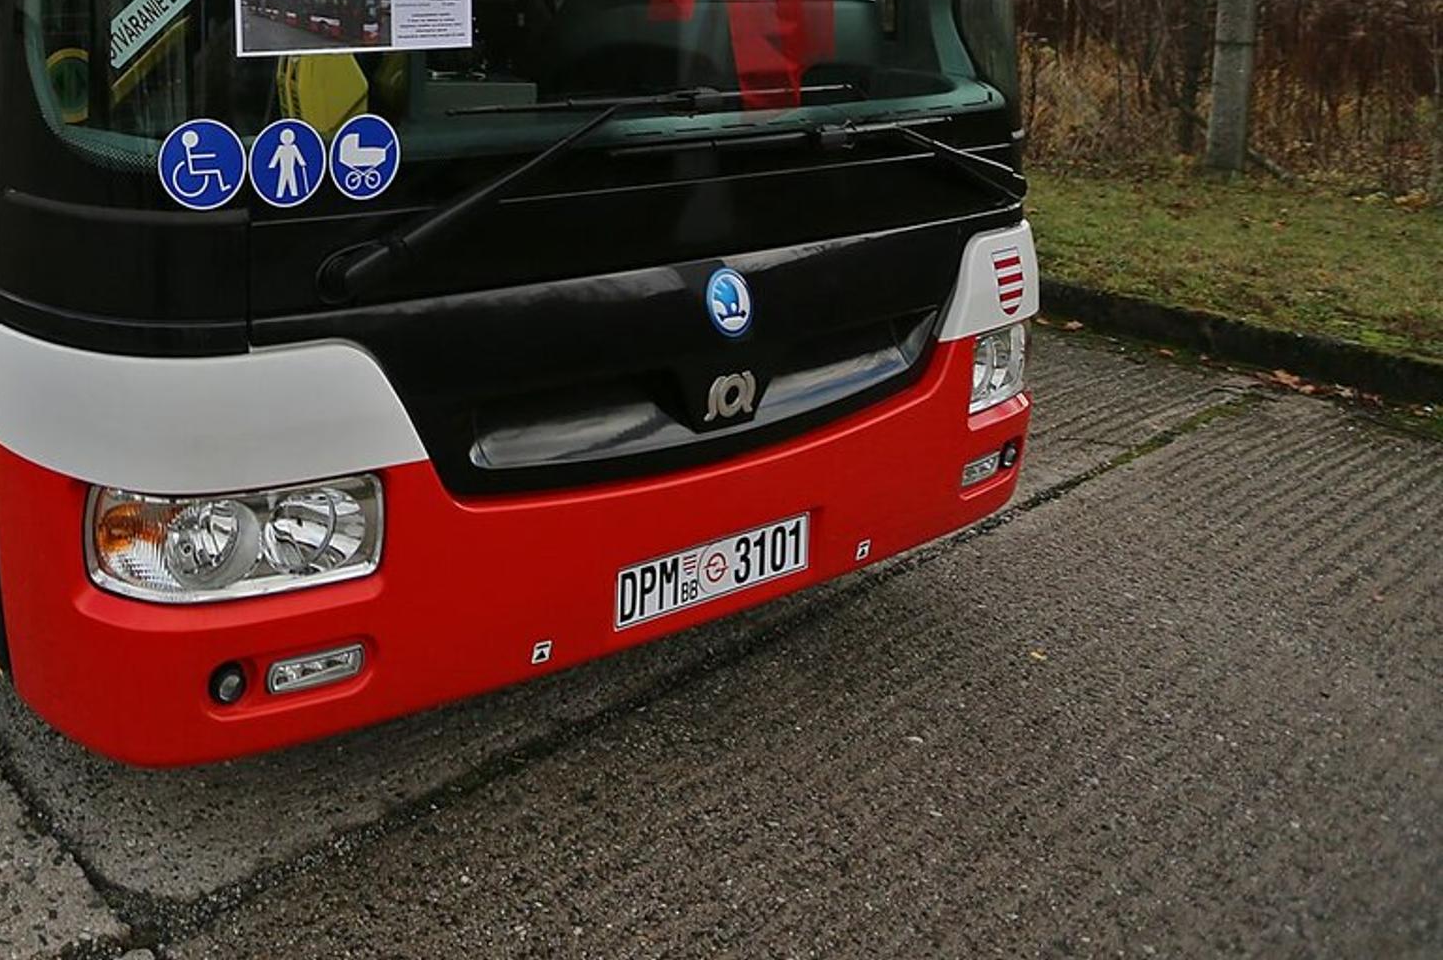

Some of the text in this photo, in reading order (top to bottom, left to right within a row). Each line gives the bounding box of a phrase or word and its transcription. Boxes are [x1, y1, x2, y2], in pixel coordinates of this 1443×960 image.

[620, 520, 801, 623] DPM BB 3101
